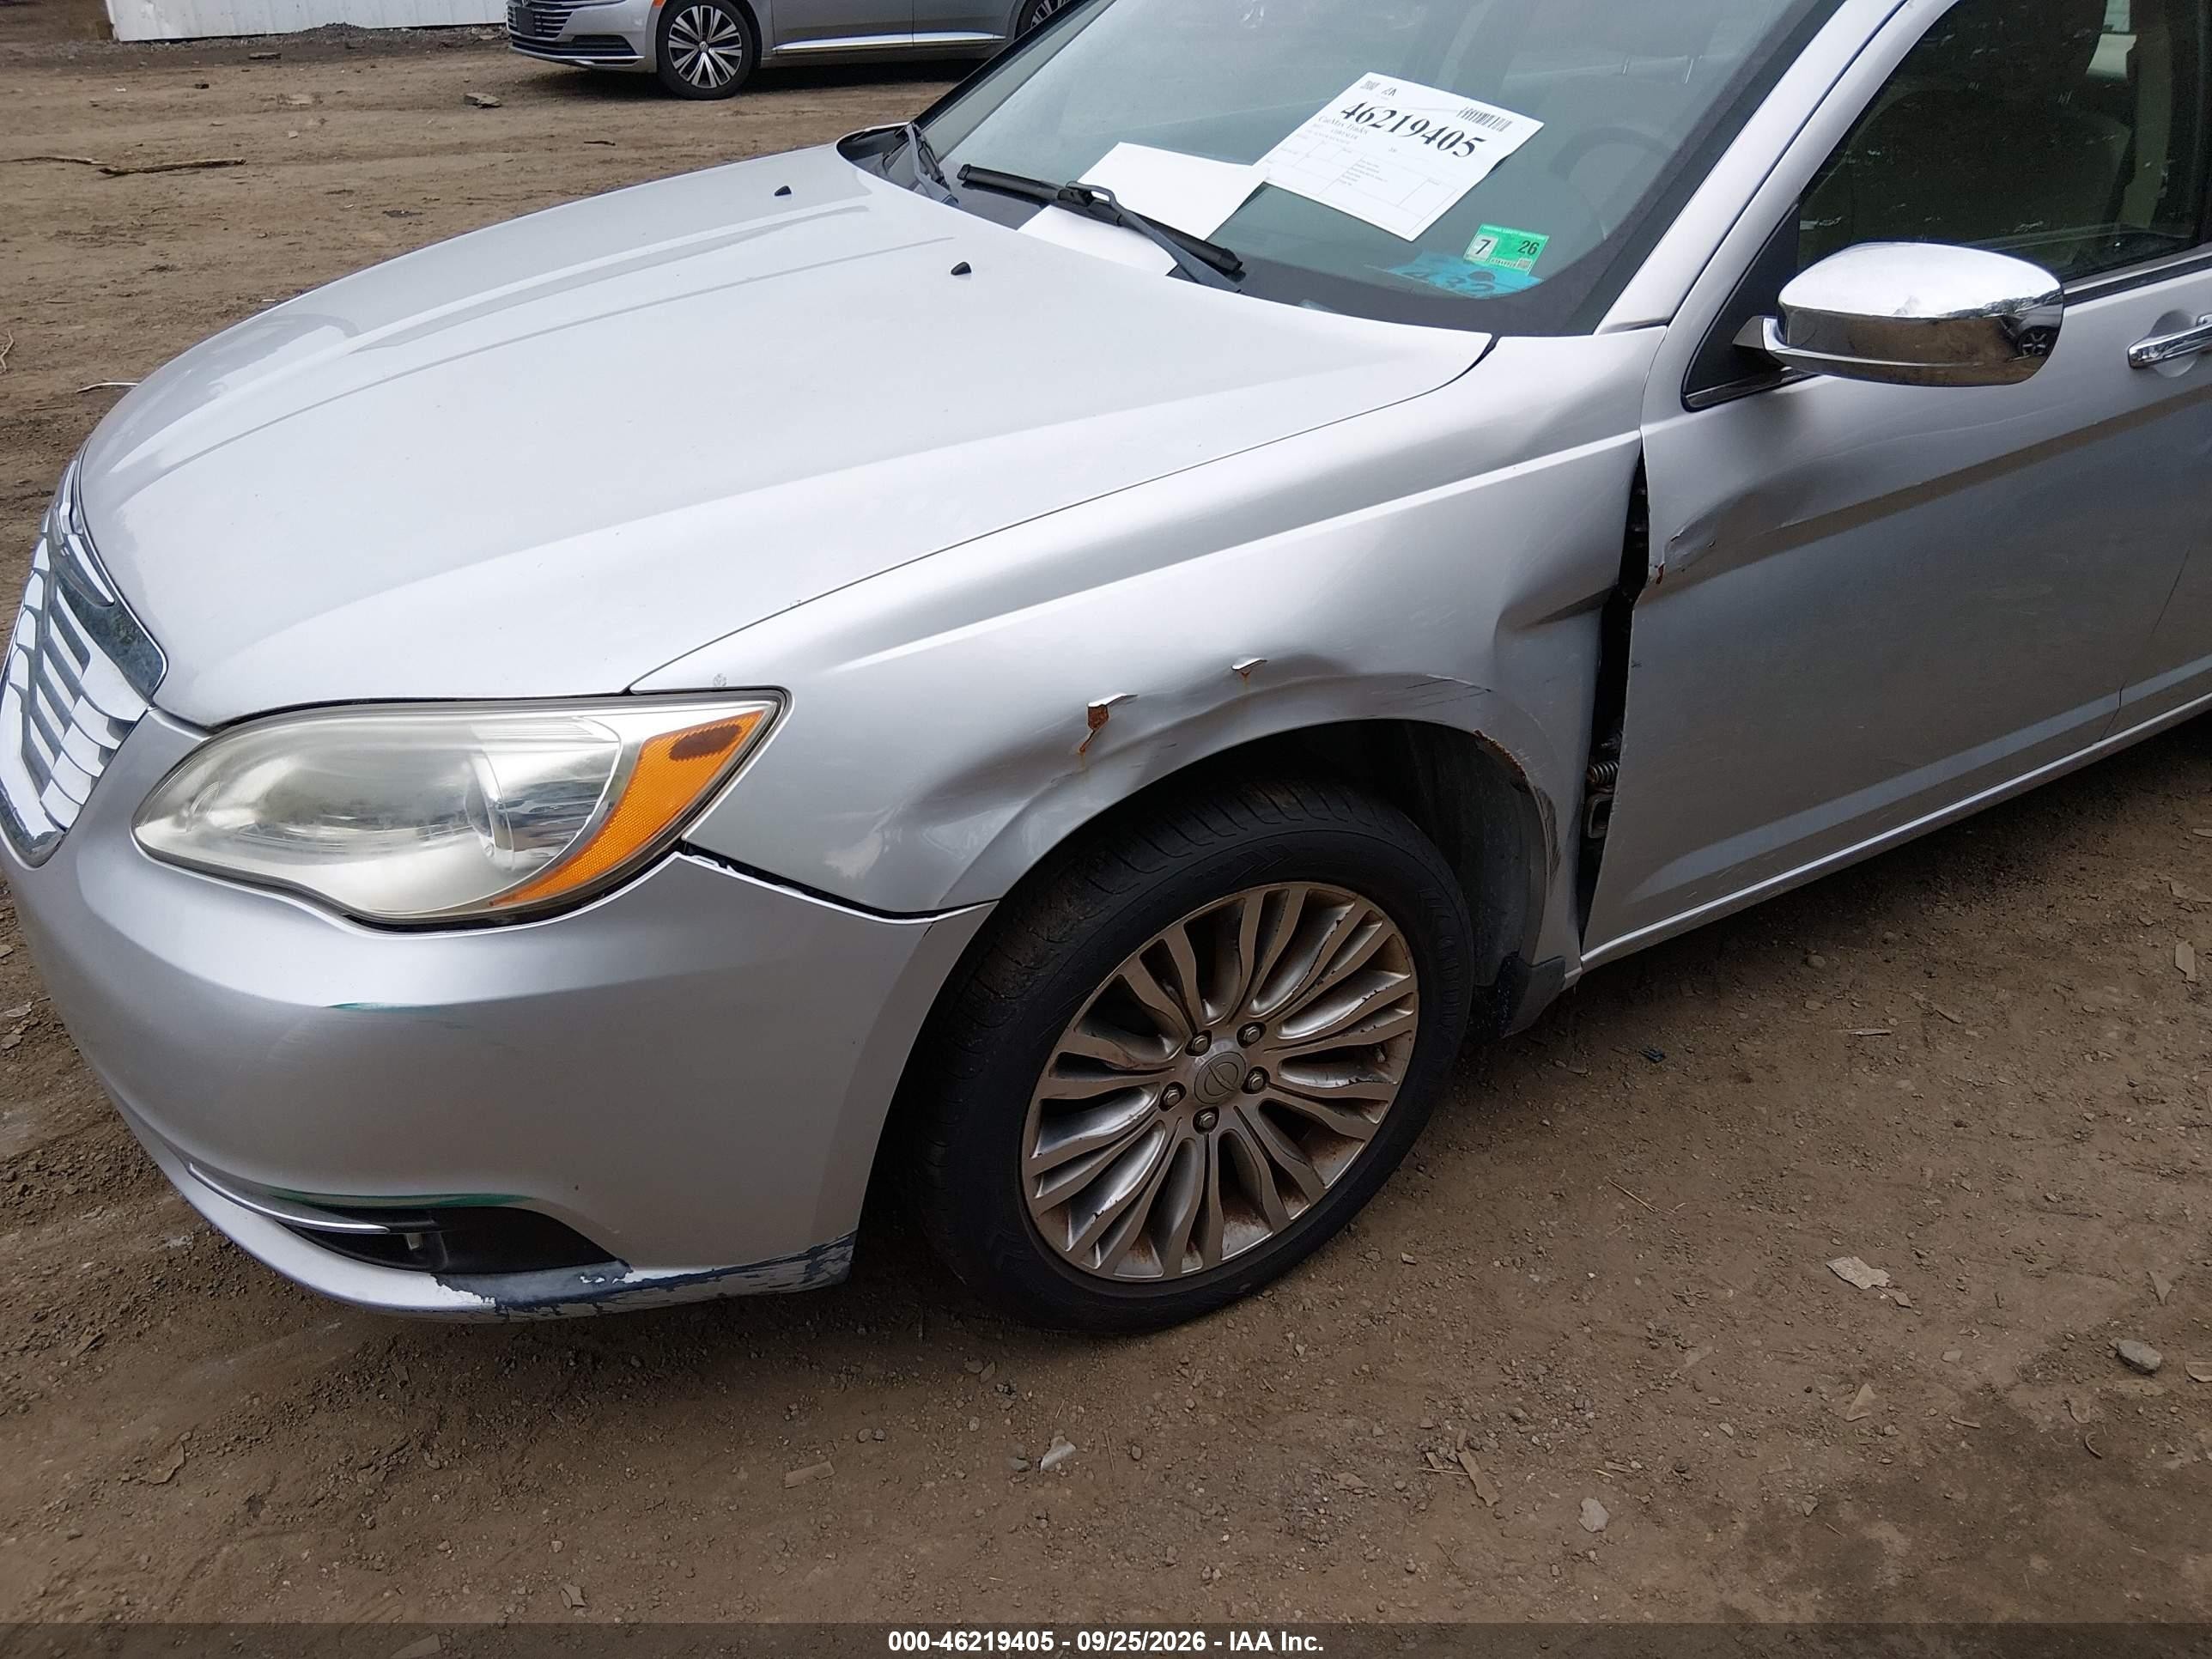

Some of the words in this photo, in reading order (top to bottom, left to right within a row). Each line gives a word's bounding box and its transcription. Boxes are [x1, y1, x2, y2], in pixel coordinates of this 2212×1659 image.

[1340, 101, 1486, 158] 46219405
[1475, 239, 1492, 255] 7
[1517, 240, 1540, 256] 26
